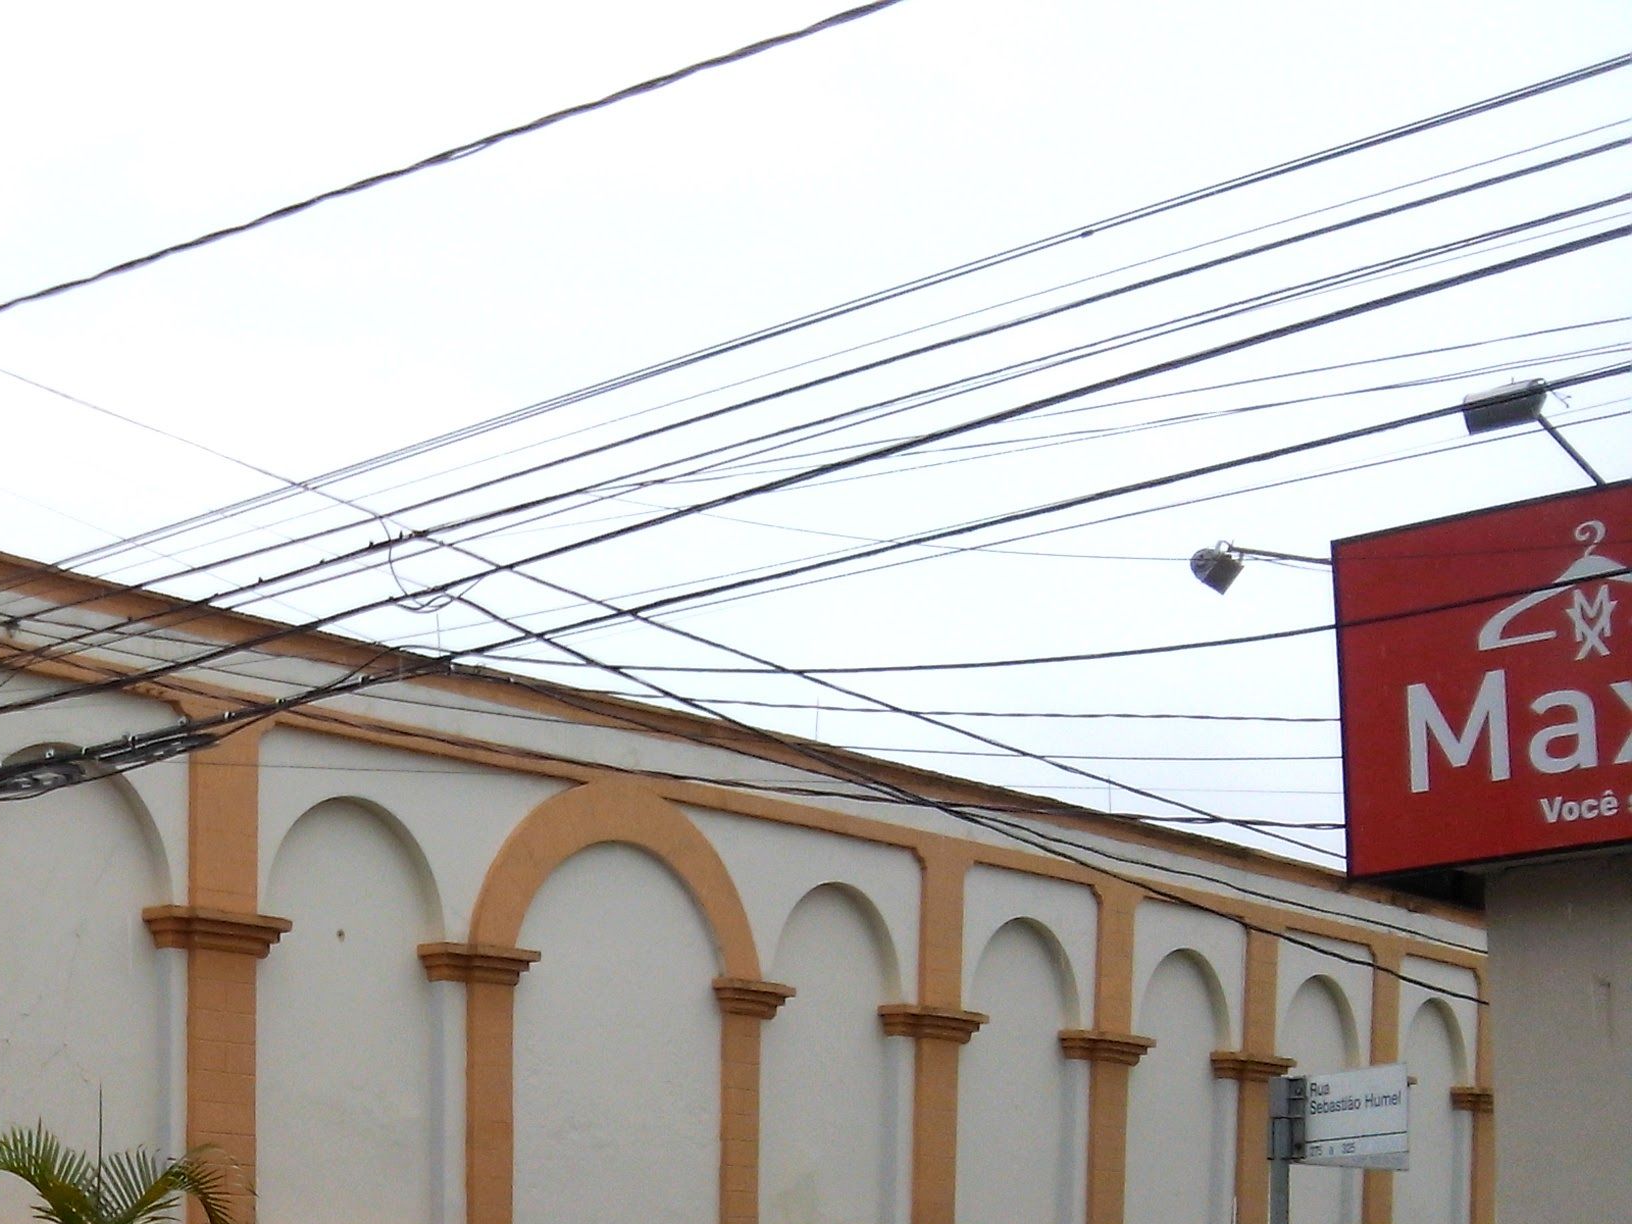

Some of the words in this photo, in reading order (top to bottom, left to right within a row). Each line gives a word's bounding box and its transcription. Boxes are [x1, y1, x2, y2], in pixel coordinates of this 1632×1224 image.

[1540, 789, 1619, 823] Você
[1310, 1082, 1330, 1097] Rua
[1310, 1096, 1361, 1115] Sebastião
[1365, 1090, 1401, 1108] Humel
